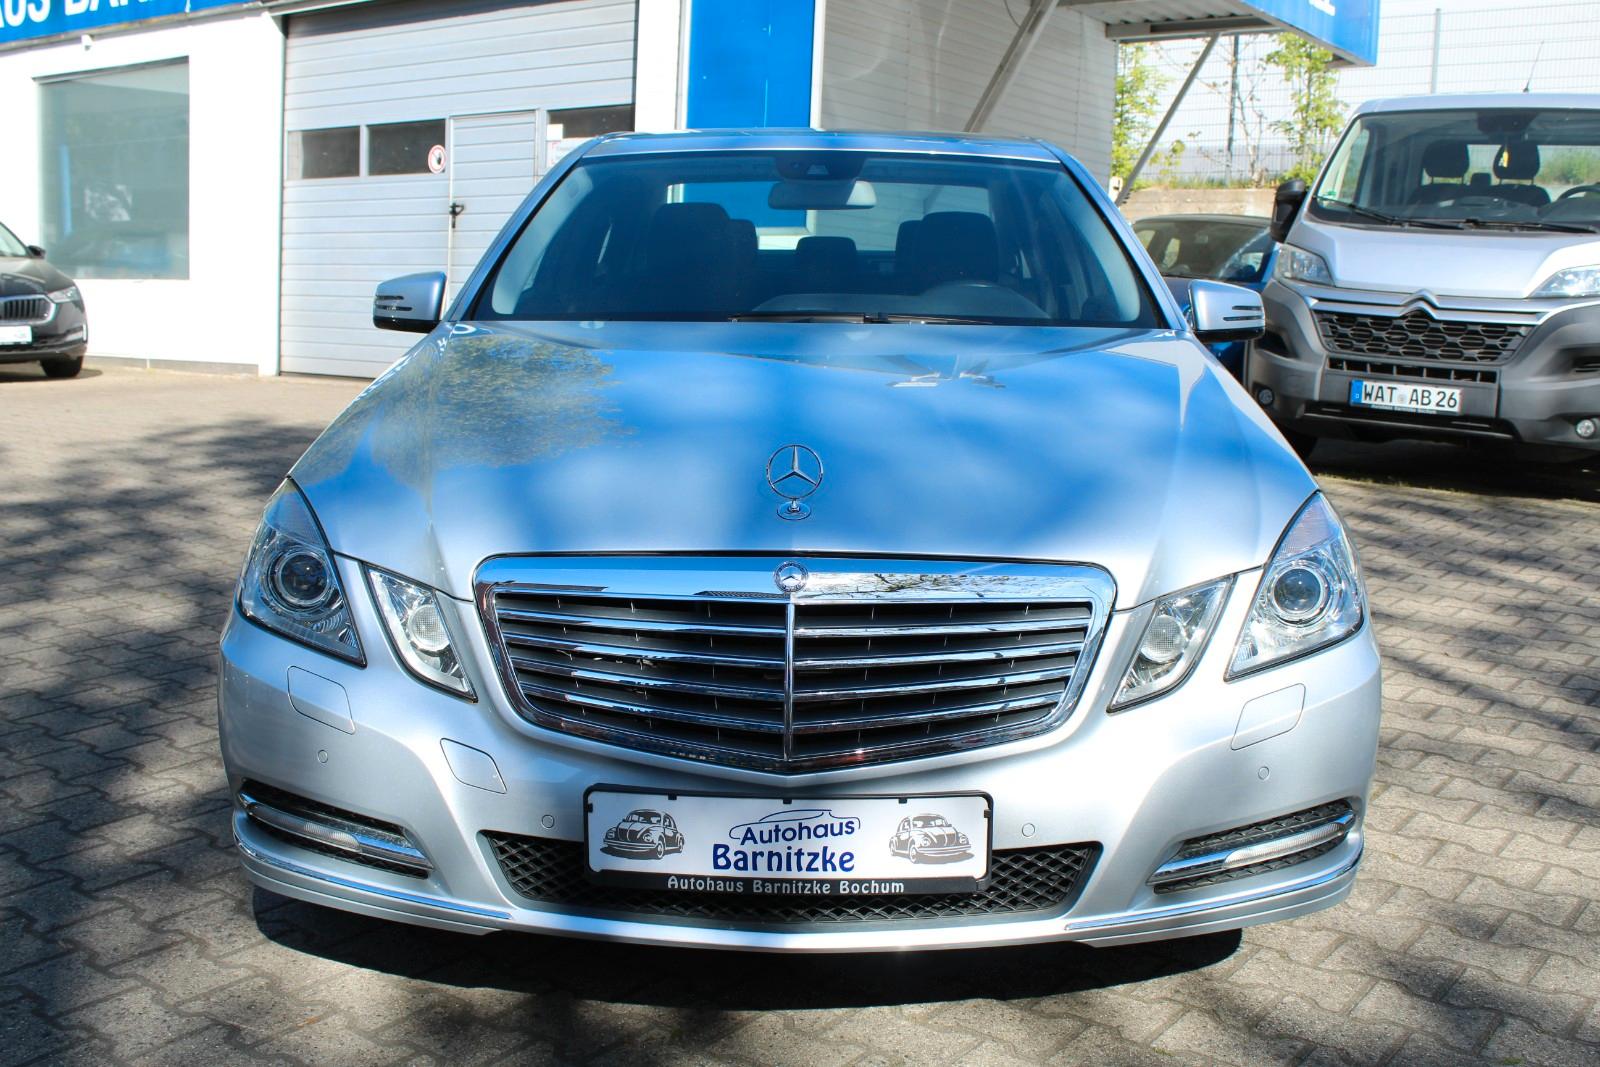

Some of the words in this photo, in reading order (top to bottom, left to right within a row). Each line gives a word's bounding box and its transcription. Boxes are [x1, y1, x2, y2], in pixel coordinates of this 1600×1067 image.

[1363, 384, 1397, 403] WAT
[740, 820, 855, 846] Autohaus
[713, 843, 855, 872] Barnitzke
[667, 875, 744, 893] Autohaus
[753, 879, 831, 894] Barnitzke
[839, 880, 905, 894] Bochum
